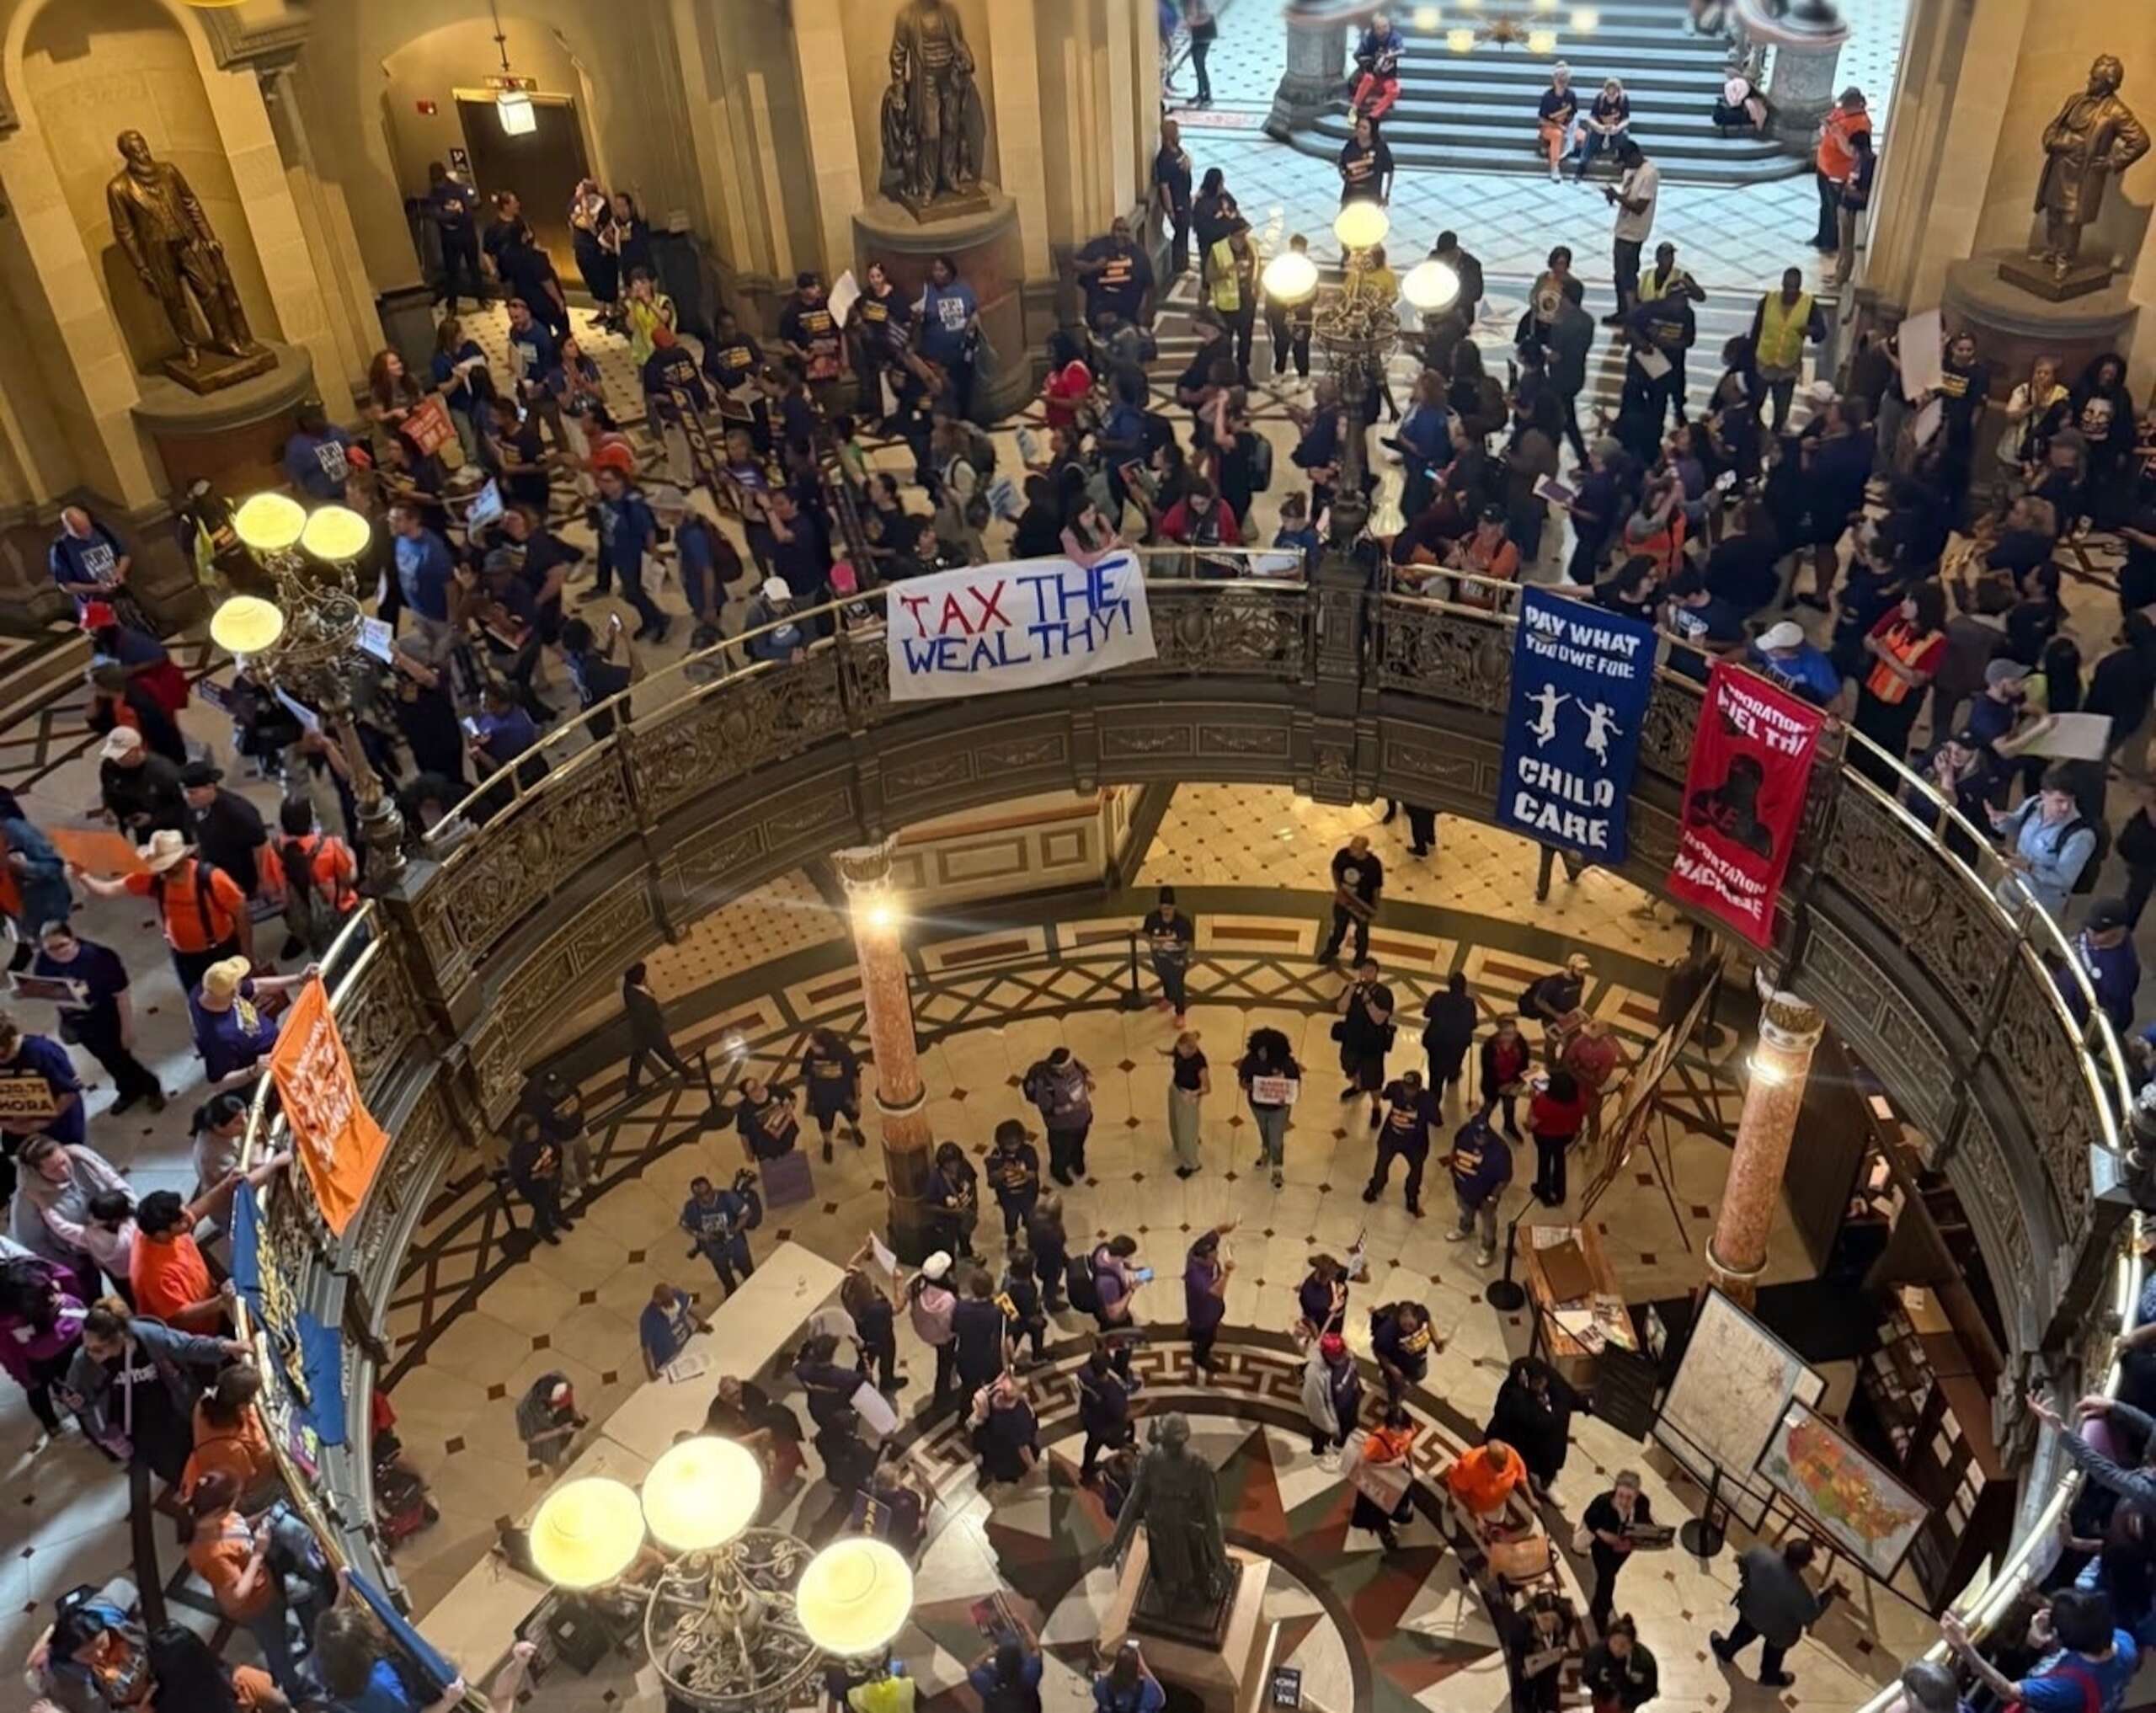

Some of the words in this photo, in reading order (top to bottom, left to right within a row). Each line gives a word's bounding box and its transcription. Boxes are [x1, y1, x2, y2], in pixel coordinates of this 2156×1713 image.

[900, 580, 1012, 638] TAX
[1017, 558, 1129, 623] THE
[901, 600, 1134, 675] WEALTHY!
[1525, 605, 1566, 637] PAY
[1570, 622, 1641, 657] WHAT
[1558, 644, 1597, 671] OWE
[1765, 726, 1807, 757] TH
[1518, 756, 1614, 808] CHILD
[1513, 790, 1609, 851] CARE
